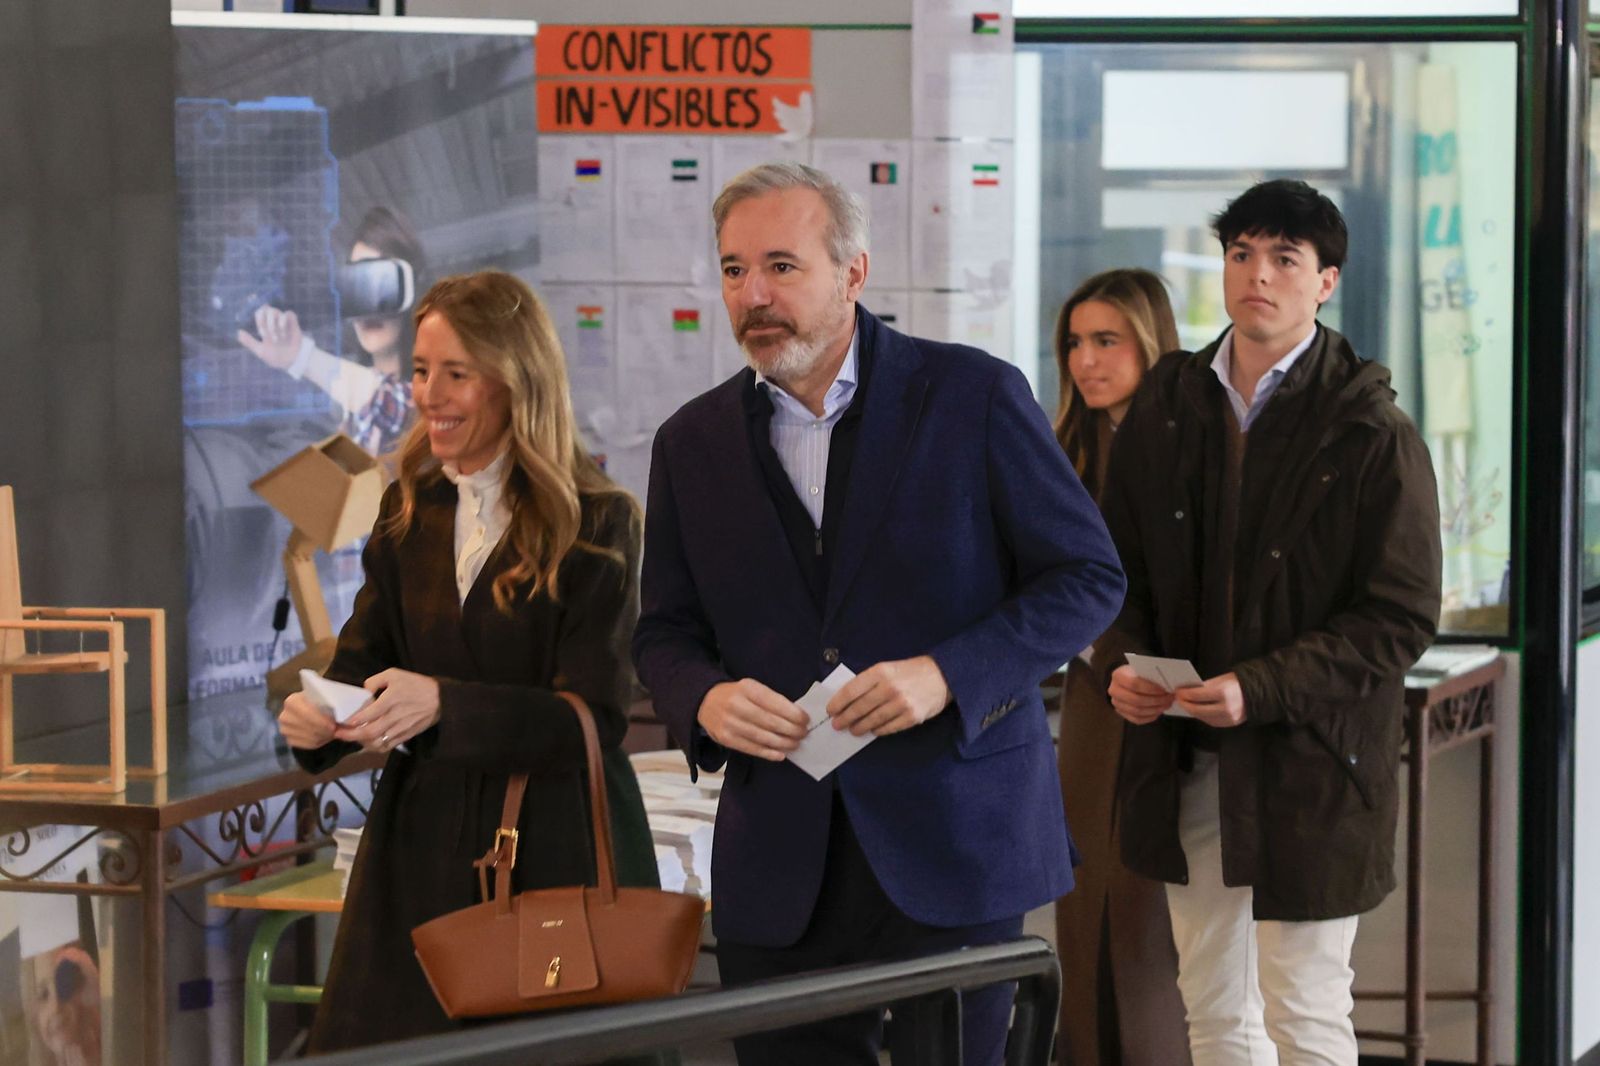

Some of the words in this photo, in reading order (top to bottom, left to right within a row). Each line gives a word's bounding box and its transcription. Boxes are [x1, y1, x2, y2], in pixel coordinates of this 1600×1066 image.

[563, 31, 772, 76] CONFLICTOS
[555, 86, 761, 128] IN-VISIBLES
[202, 646, 248, 667] AULA
[253, 643, 276, 662] DE
